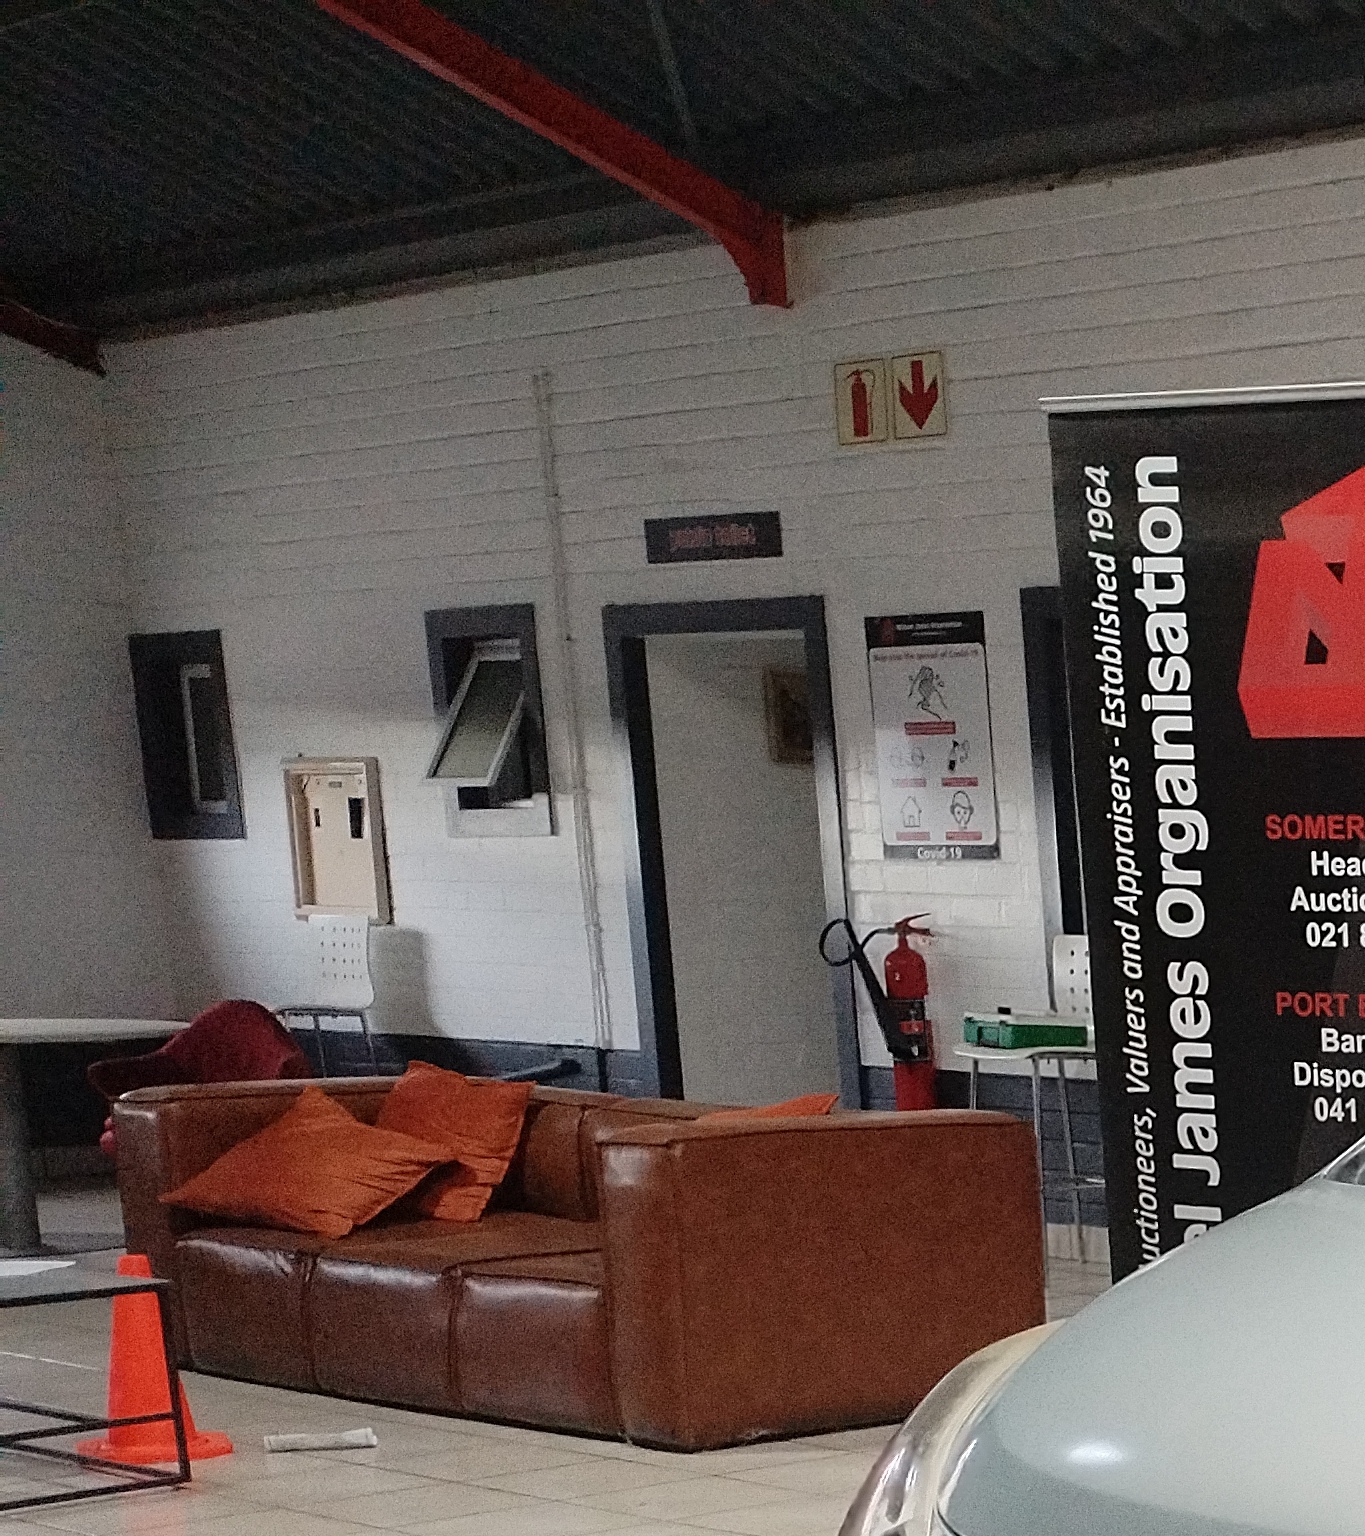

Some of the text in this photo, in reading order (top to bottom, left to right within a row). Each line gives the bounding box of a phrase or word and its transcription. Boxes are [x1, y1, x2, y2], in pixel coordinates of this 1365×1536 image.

[1084, 465, 1114, 541] 1964
[1088, 551, 1126, 728] Established
[1132, 456, 1209, 938] Organisation
[1106, 755, 1143, 916] Appraisers
[1114, 920, 1144, 980] and
[1305, 922, 1349, 948] 021
[1122, 987, 1151, 1094] Valuers
[1275, 991, 1350, 1018] PORT
[1167, 960, 1221, 1187] James
[1314, 1096, 1358, 1122] 041
[1133, 1107, 1161, 1268] uctioneers,
